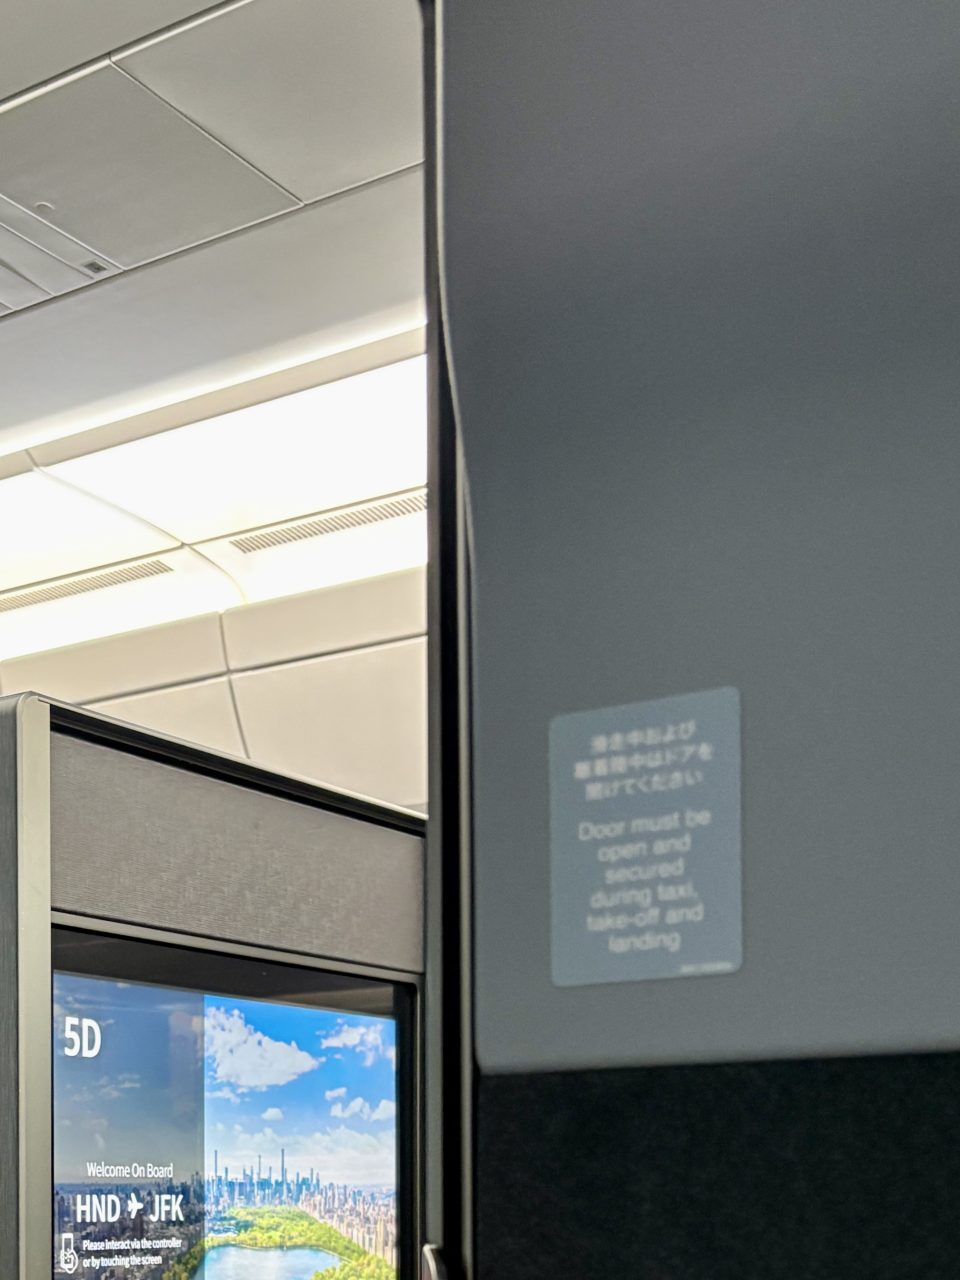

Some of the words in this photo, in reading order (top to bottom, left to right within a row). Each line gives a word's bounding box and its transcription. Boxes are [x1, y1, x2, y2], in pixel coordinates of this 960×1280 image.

[578, 821, 625, 841] Door
[630, 810, 680, 833] must
[684, 808, 712, 828] be
[597, 841, 648, 863] open
[652, 832, 692, 855] and
[605, 857, 685, 884] secured
[589, 887, 652, 909] during
[665, 902, 704, 925] and
[608, 931, 681, 953] landing
[64, 1016, 102, 1058] 5D
[86, 1161, 130, 1178] Welcome
[131, 1162, 146, 1178] On
[146, 1162, 174, 1178] Board
[76, 1194, 121, 1223] HND
[149, 1194, 185, 1222] JFK
[82, 1240, 105, 1251] Please
[105, 1239, 131, 1250] interact
[130, 1238, 141, 1249] via
[140, 1237, 153, 1249] the
[152, 1236, 183, 1249] controller
[82, 1259, 92, 1268] or
[91, 1256, 101, 1270] by
[100, 1255, 131, 1268] touching
[129, 1254, 142, 1266] the
[141, 1254, 163, 1265] screen
